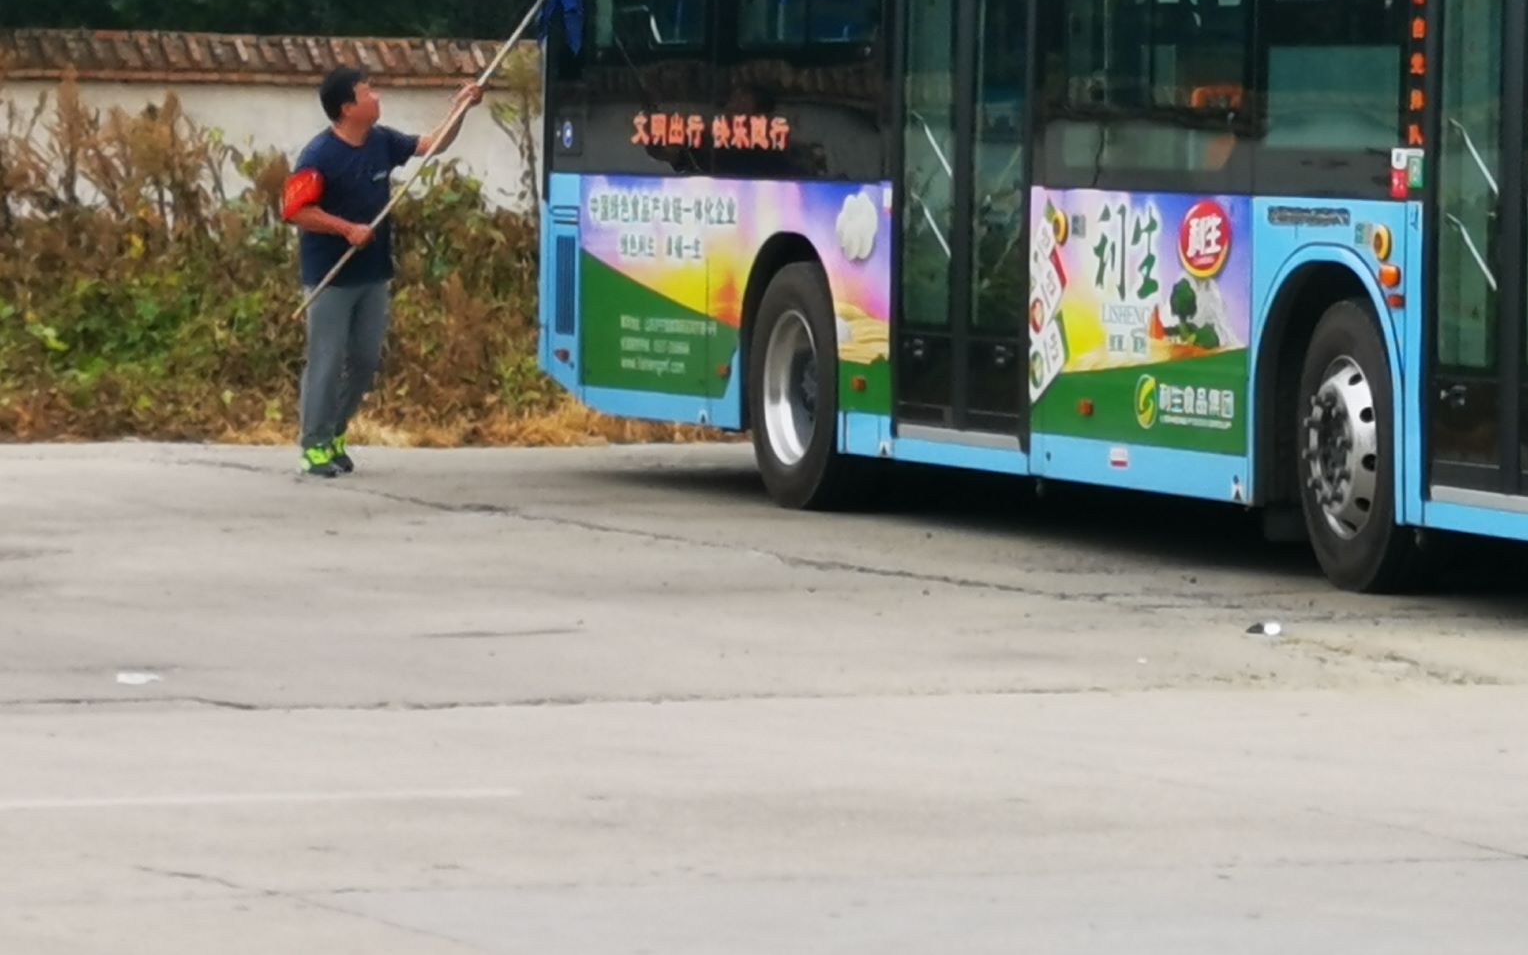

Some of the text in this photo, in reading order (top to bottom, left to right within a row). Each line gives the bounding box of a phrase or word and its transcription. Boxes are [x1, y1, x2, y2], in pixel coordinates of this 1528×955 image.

[631, 110, 789, 151] 文明出行 快乐随行
[1159, 383, 1235, 419] 利生食品集团
